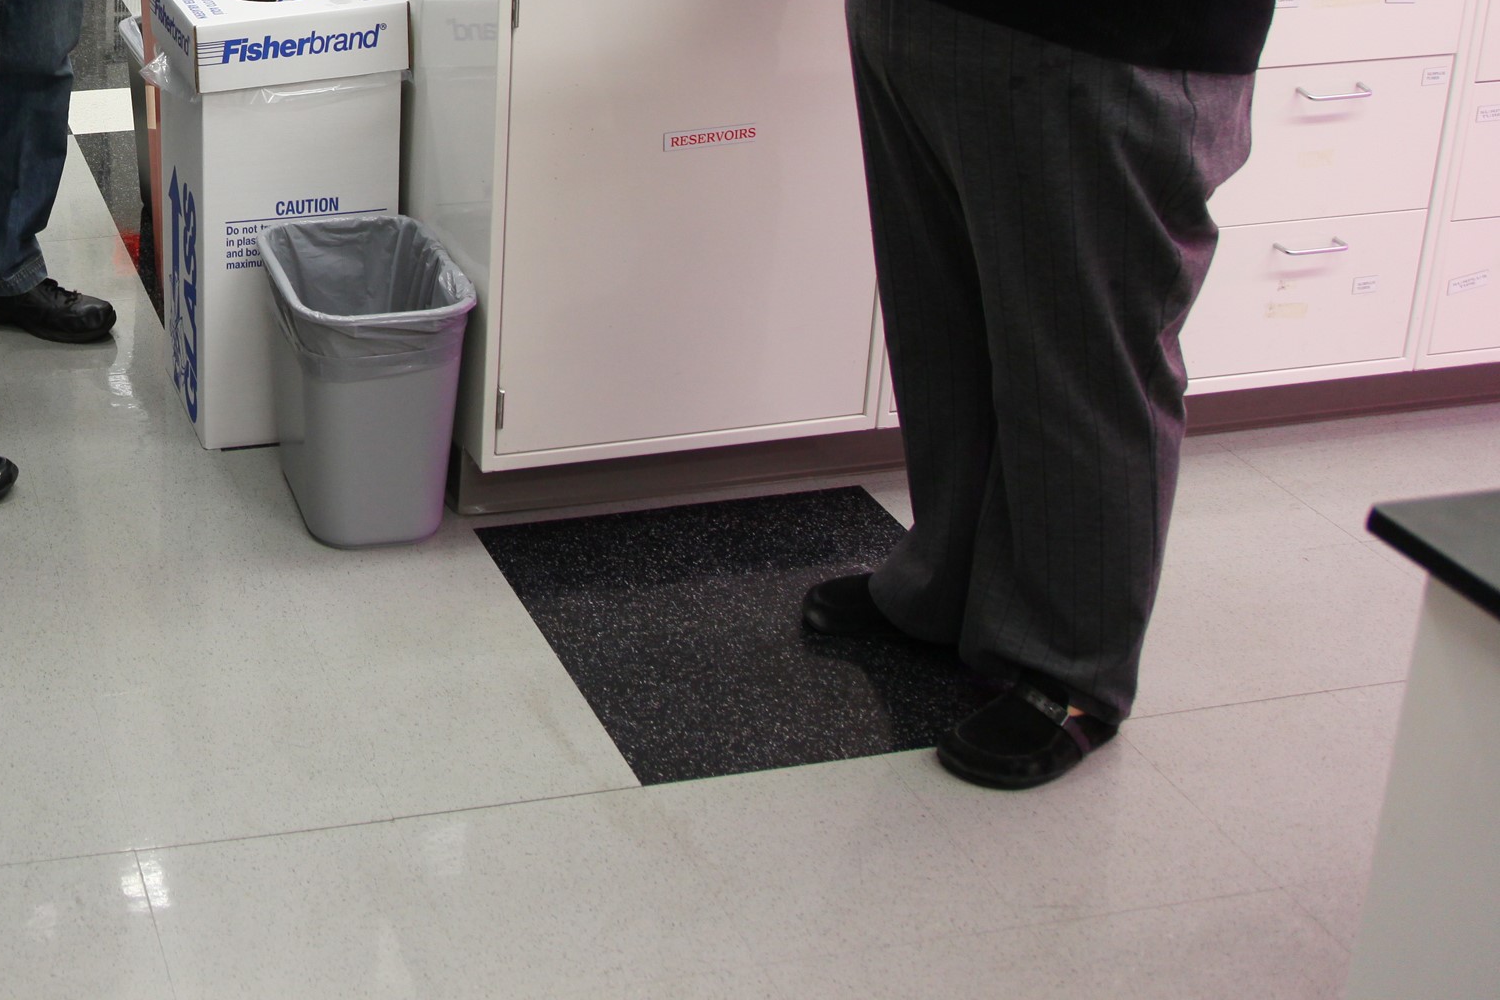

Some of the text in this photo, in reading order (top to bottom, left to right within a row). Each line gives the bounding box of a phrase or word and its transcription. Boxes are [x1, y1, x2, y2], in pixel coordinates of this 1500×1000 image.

[671, 128, 756, 147] RESERVOIRS
[276, 197, 339, 216] CAUTION
[226, 226, 239, 236] Do
[242, 225, 257, 234] not
[226, 236, 257, 248] in plas
[226, 250, 243, 258] and
[226, 259, 264, 270] maximu
[183, 182, 198, 424] GLASS
